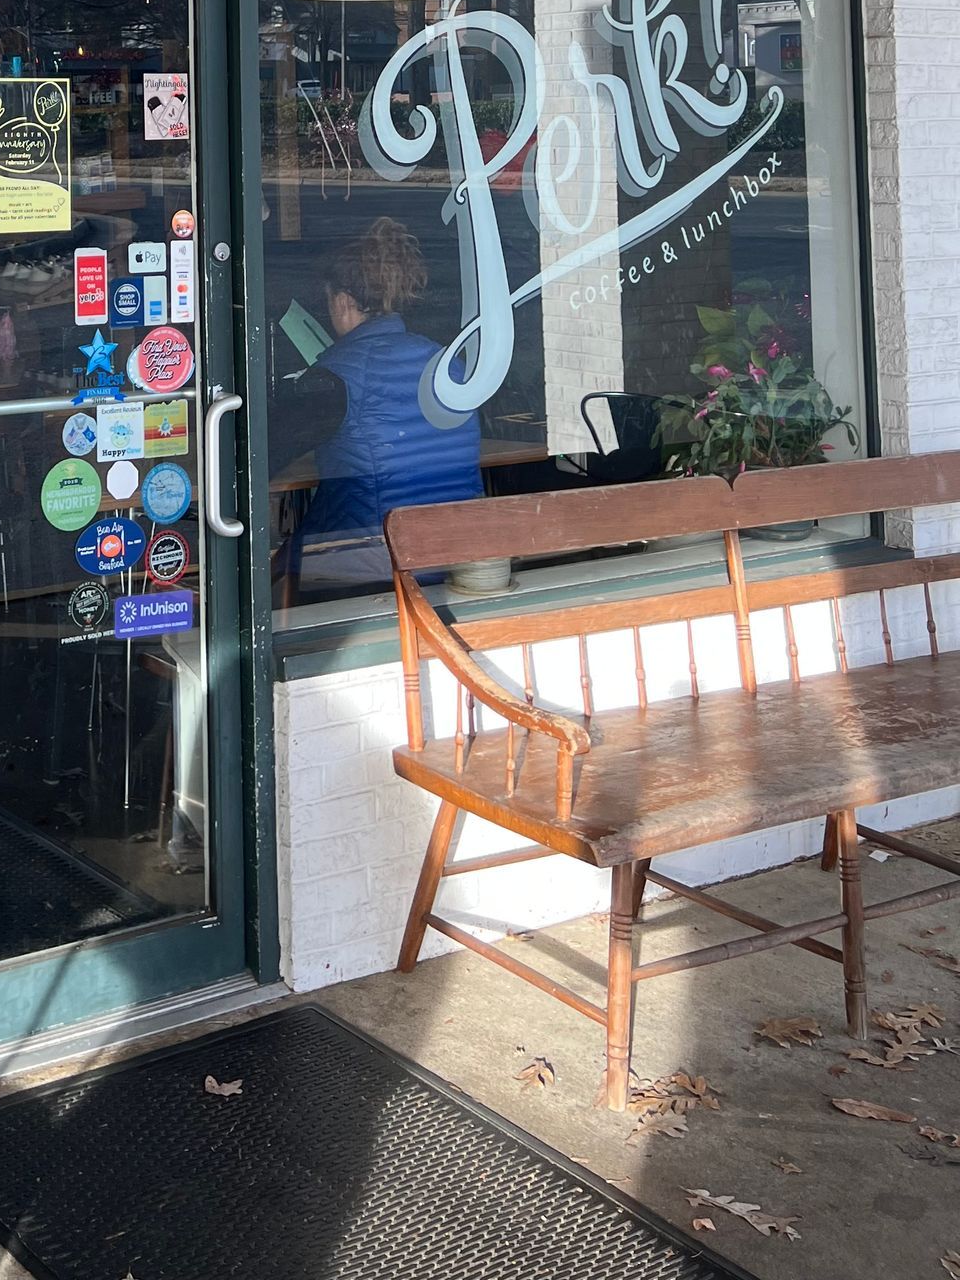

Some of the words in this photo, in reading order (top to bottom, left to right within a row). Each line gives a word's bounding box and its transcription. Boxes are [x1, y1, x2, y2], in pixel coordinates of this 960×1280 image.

[145, 78, 187, 91] Nightingale
[569, 256, 655, 310] coffee
[660, 241, 678, 263] &
[681, 152, 782, 249] lunchbox
[145, 251, 162, 266] Pay
[79, 292, 97, 304] yelp
[97, 372, 125, 386] Best
[86, 388, 112, 396] FINALIST
[46, 494, 96, 512] FAVORITE
[99, 556, 125, 570] Seafood
[152, 551, 183, 562] RICHMOND
[140, 600, 188, 617] InUnison
[61, 634, 87, 645] PROUDLY
[87, 631, 103, 640] SOLD
